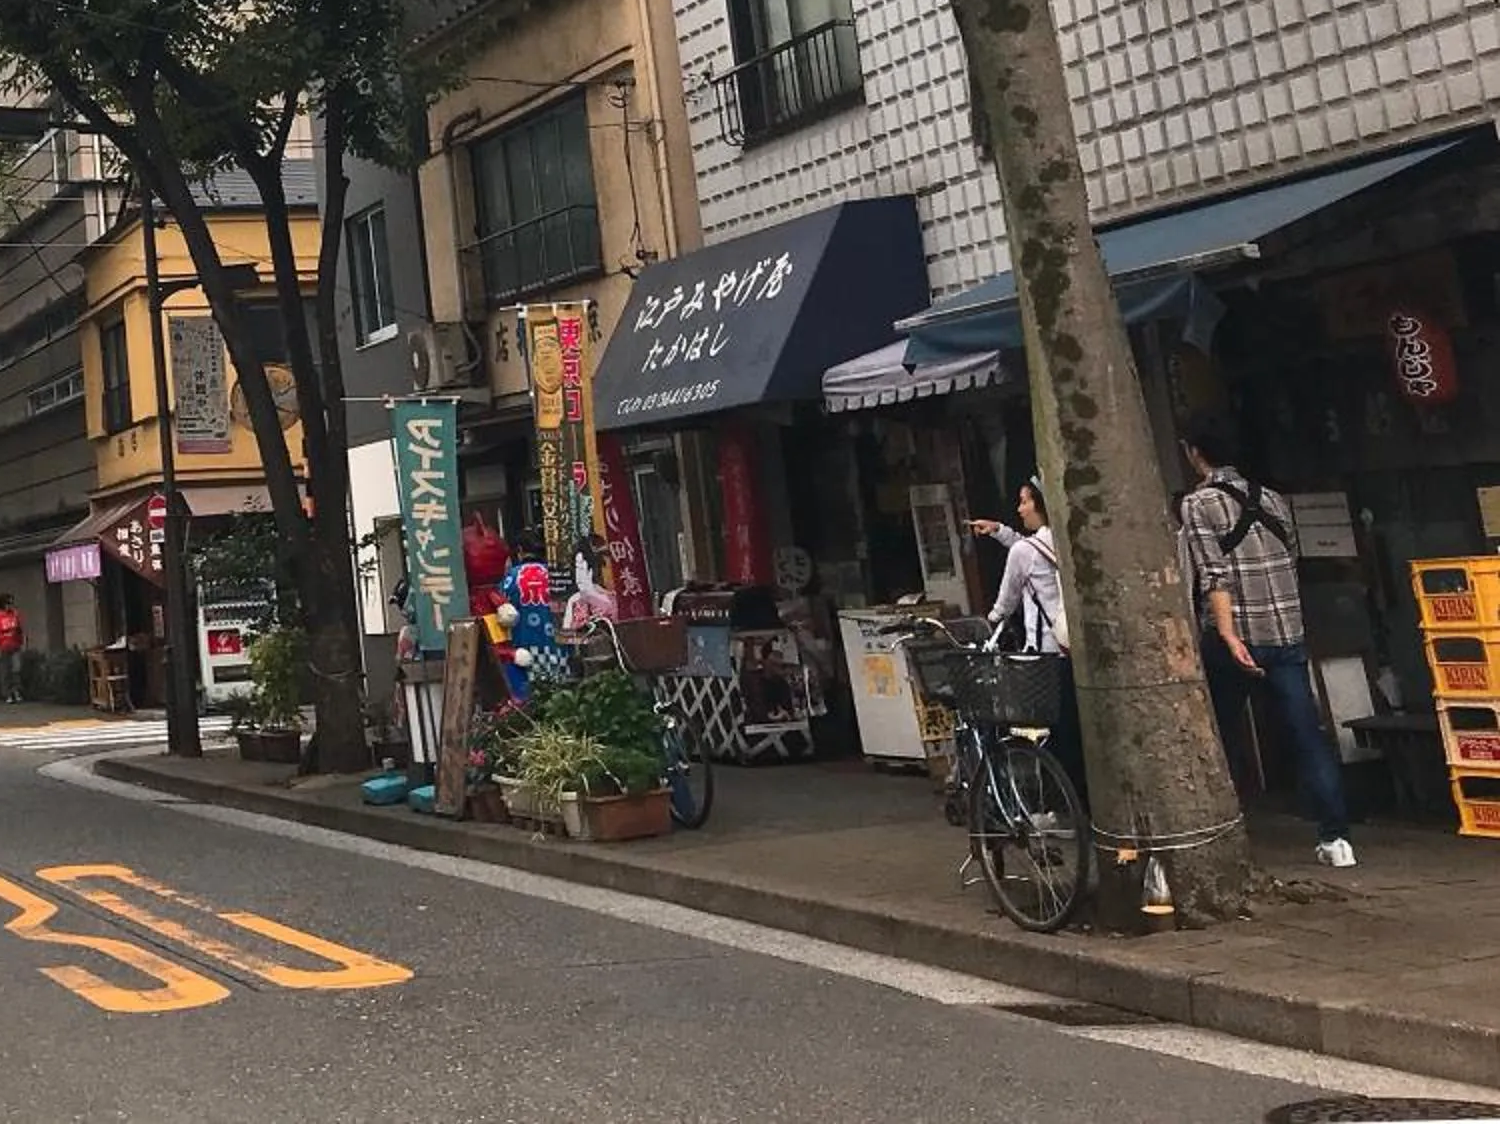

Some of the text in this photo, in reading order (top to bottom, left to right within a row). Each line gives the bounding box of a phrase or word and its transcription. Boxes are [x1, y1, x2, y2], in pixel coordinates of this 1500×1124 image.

[634, 252, 793, 332] 江戸みやげ屋
[642, 322, 731, 372] たかはし
[1433, 595, 1476, 616] KIRIN
[1445, 665, 1488, 685] KIRIN
